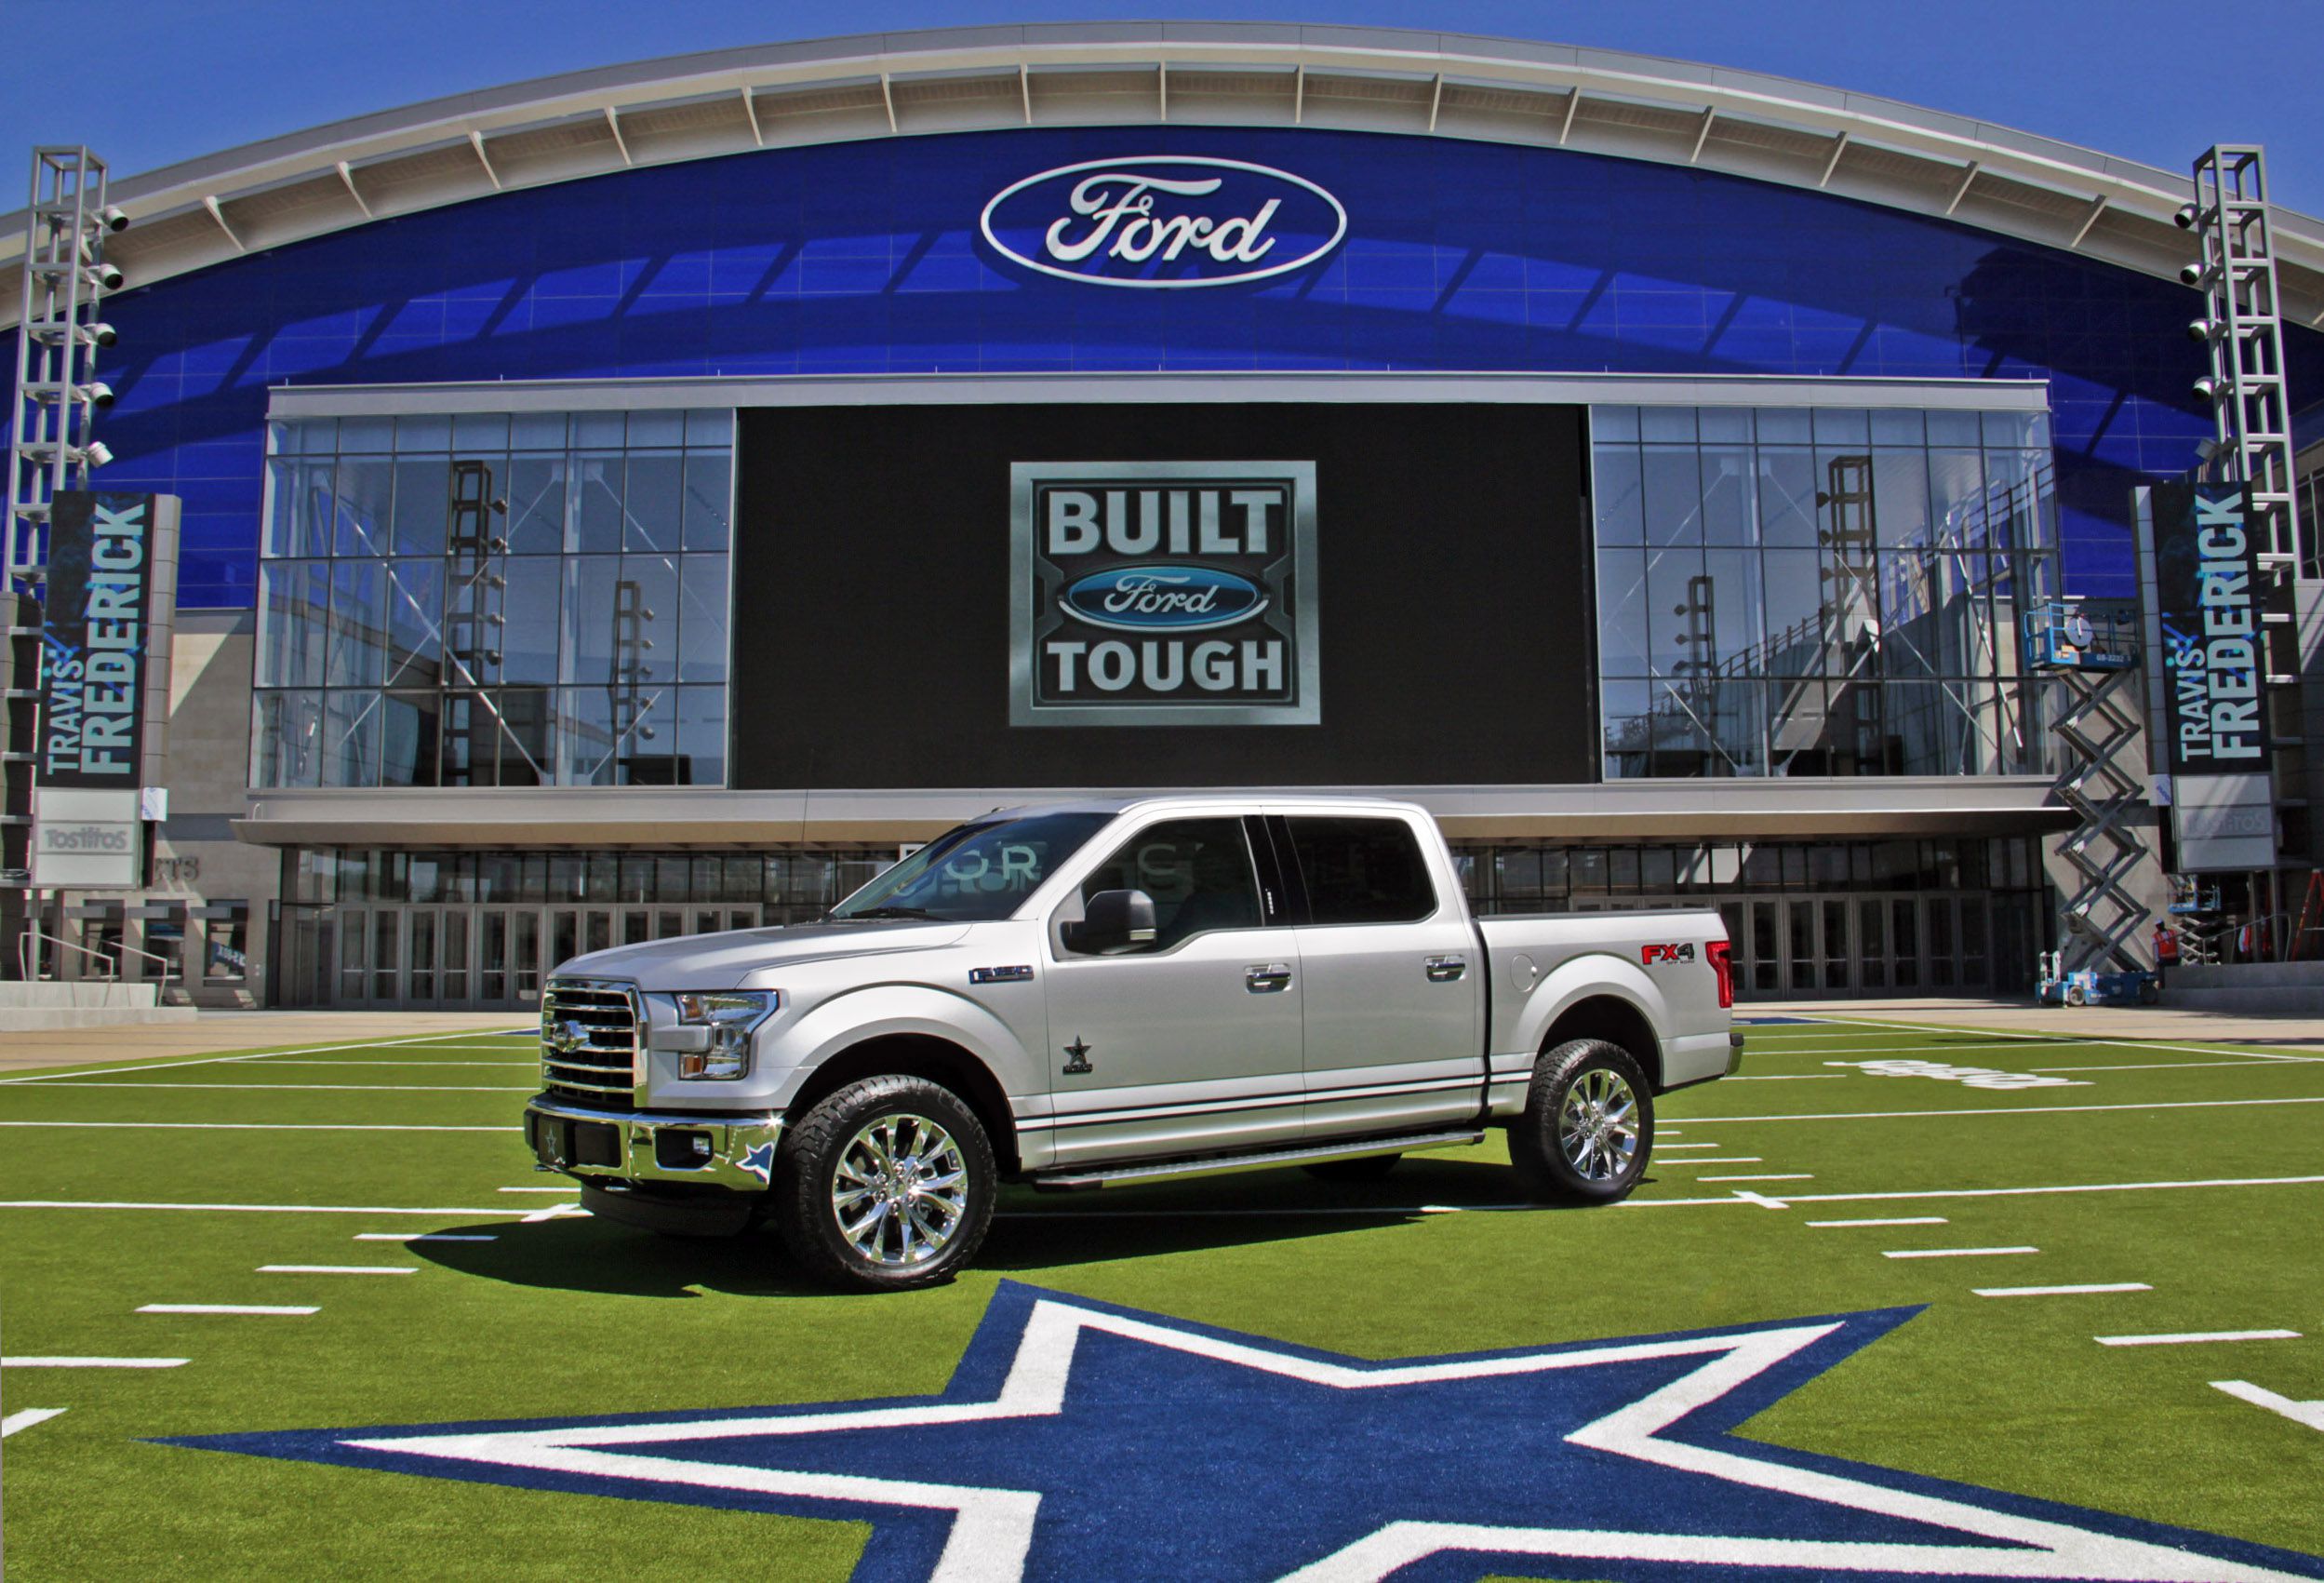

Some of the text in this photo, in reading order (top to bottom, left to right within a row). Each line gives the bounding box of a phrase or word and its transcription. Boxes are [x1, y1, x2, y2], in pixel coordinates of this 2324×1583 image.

[1046, 173, 1282, 263] Ford
[1048, 490, 1282, 555] BUILT
[1103, 573, 1220, 614] Ford
[2195, 491, 2262, 759] FREDERICK
[80, 503, 145, 773] FREDERICK
[1047, 640, 1283, 691] TOUGH
[47, 660, 85, 775] TRAVIS
[2176, 649, 2211, 762] TRAVIS
[44, 826, 128, 851] Tostitos
[2187, 812, 2265, 834] ostitos
[1641, 943, 1695, 965] FX4
